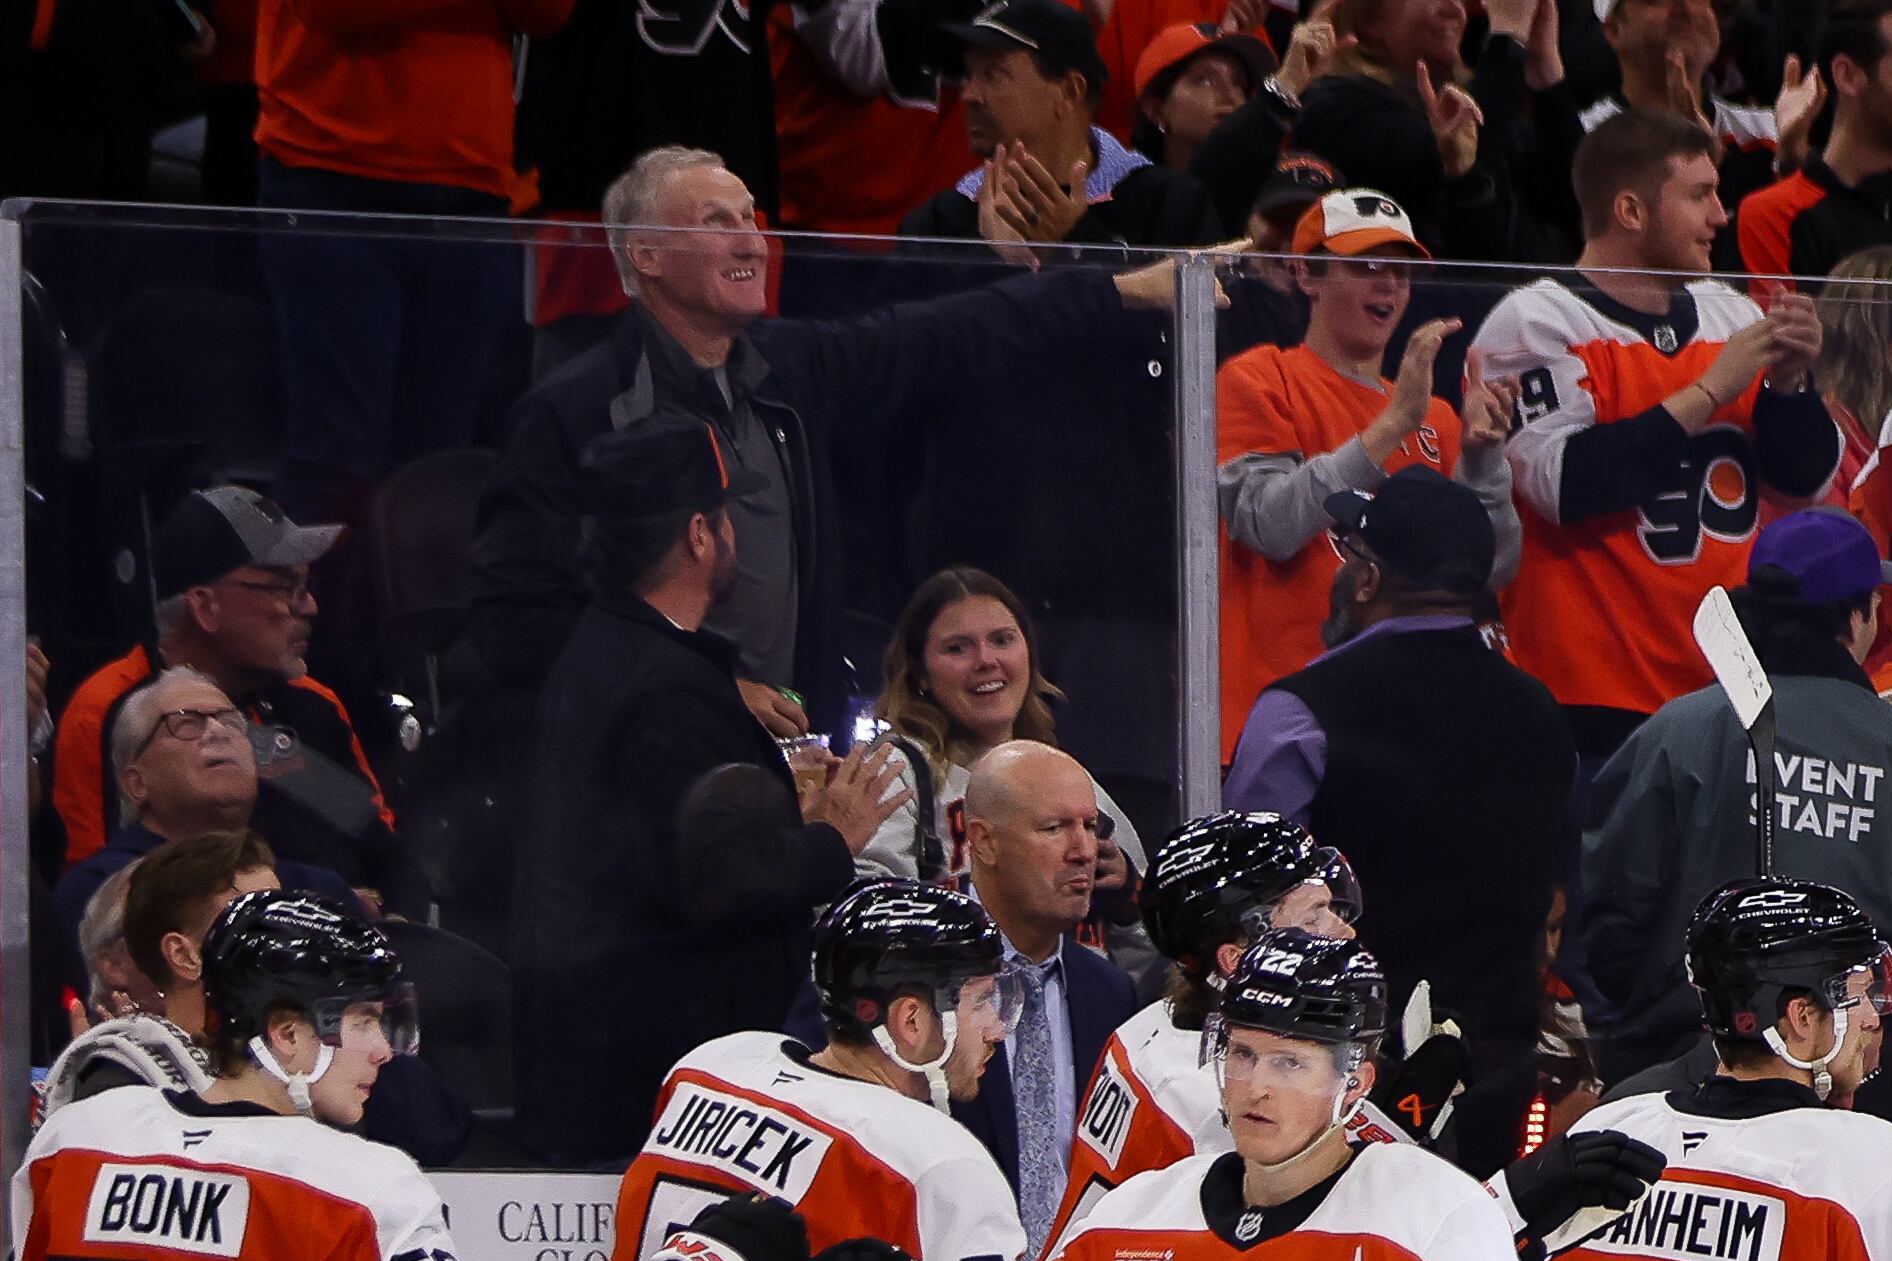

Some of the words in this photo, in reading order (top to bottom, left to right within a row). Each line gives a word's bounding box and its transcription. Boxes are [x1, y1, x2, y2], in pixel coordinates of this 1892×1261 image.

[1738, 907, 1811, 920] CHEVROLET
[1259, 948, 1304, 977] 22
[1241, 987, 1294, 1008] CCM
[657, 1094, 814, 1191] JIRICEK
[101, 1172, 231, 1245] BONK
